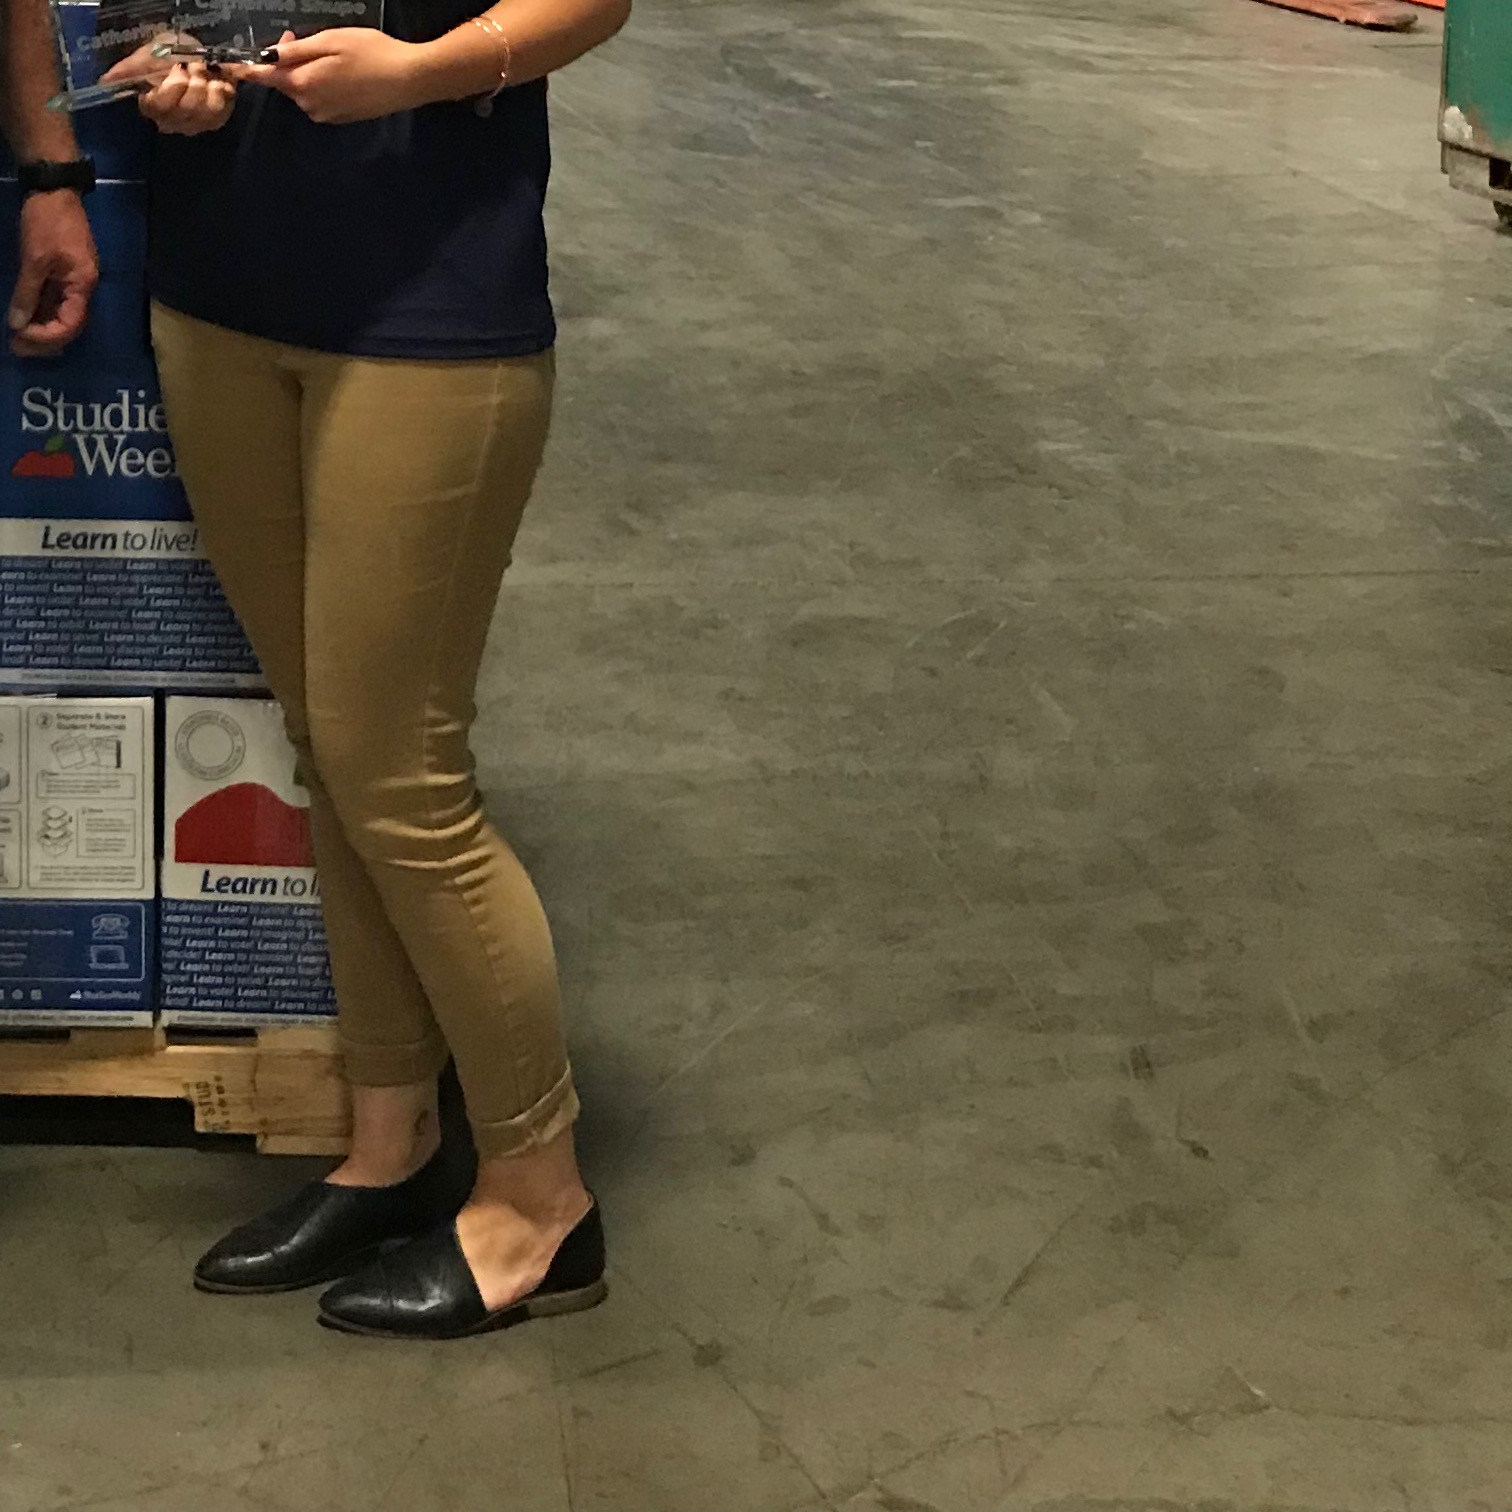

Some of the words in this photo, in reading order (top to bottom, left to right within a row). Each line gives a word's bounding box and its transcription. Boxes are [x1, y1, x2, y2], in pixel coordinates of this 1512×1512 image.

[21, 387, 167, 432] Studie
[72, 433, 170, 478] Wee
[42, 526, 117, 550] Learn
[123, 530, 146, 550] to
[150, 528, 199, 552] live!
[201, 869, 276, 895] Learn
[283, 876, 306, 896] to
